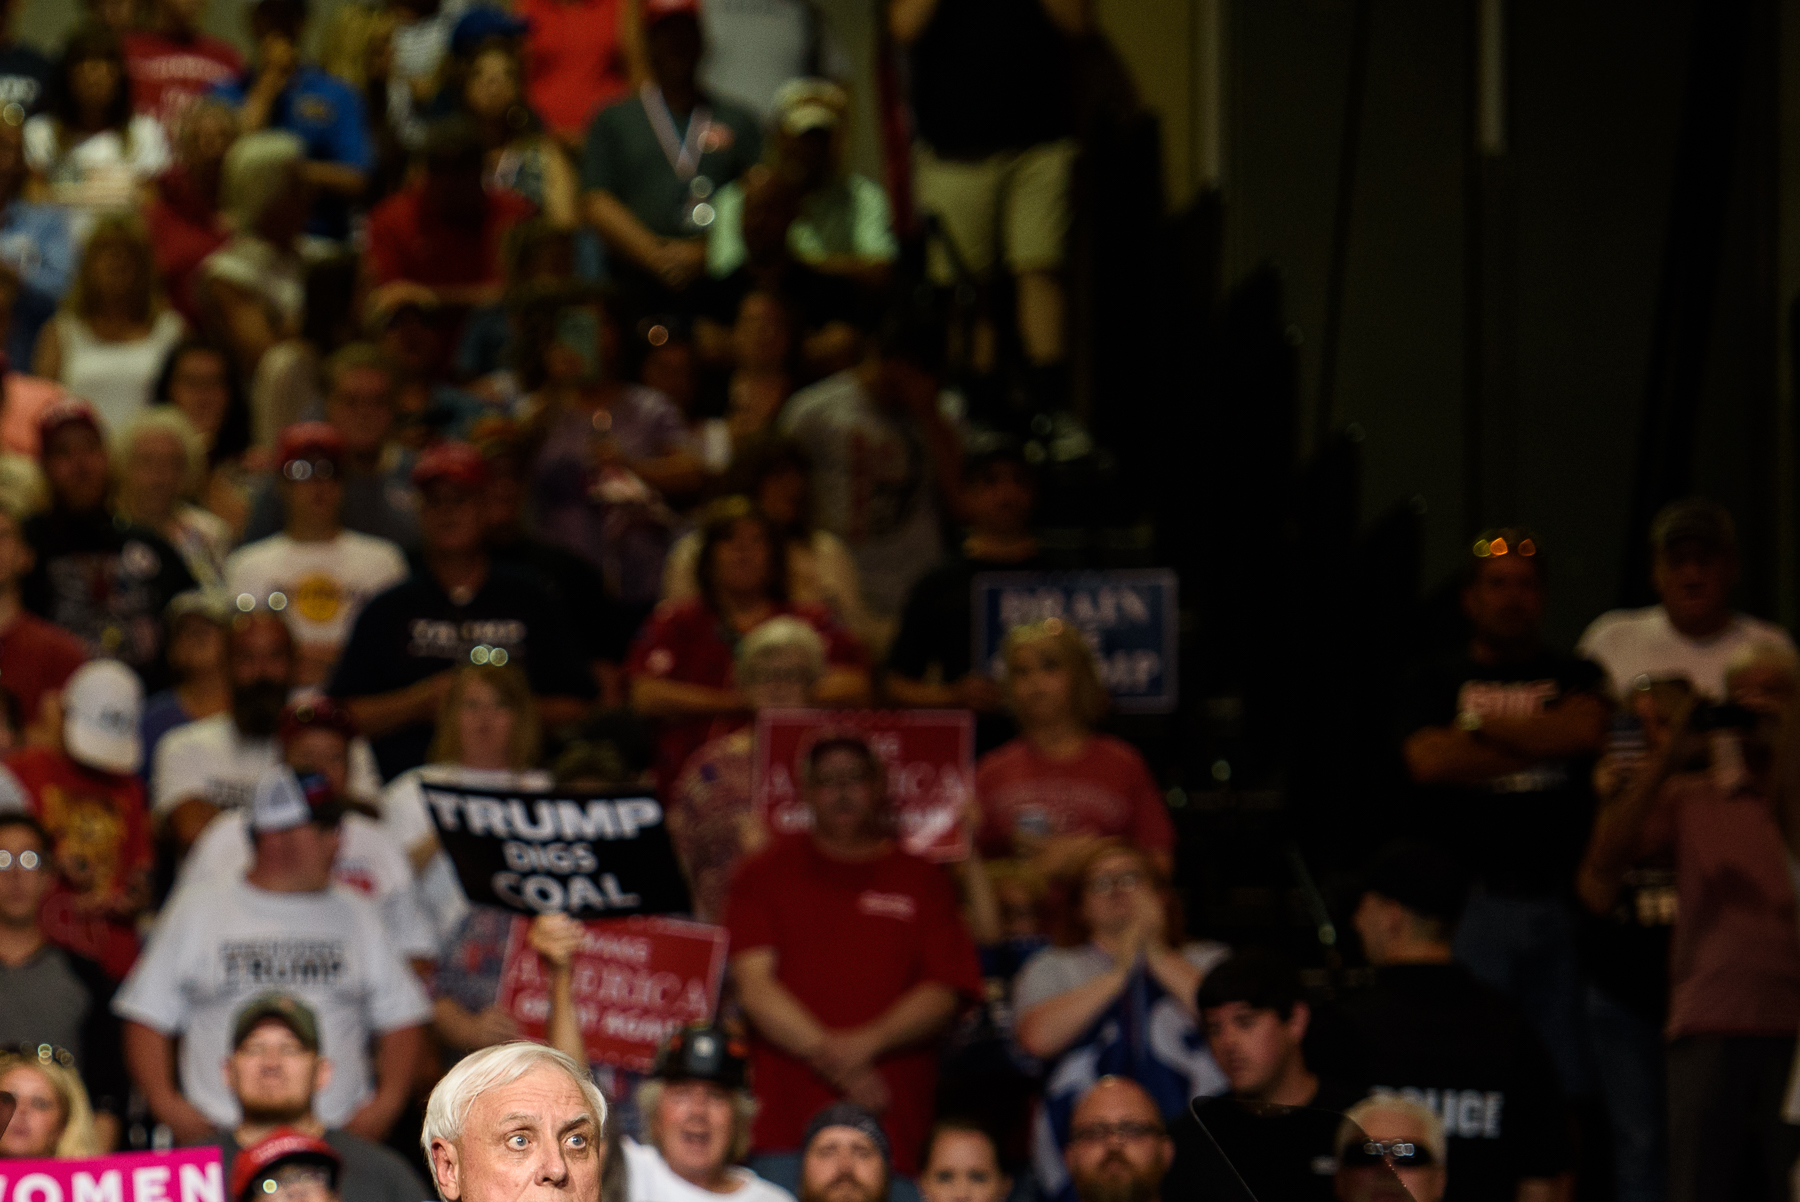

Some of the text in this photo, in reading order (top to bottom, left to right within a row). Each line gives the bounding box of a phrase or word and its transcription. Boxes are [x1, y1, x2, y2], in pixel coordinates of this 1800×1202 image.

[428, 793, 664, 842] TRUMP
[501, 841, 600, 876] DIGS
[490, 869, 643, 914] COAL
